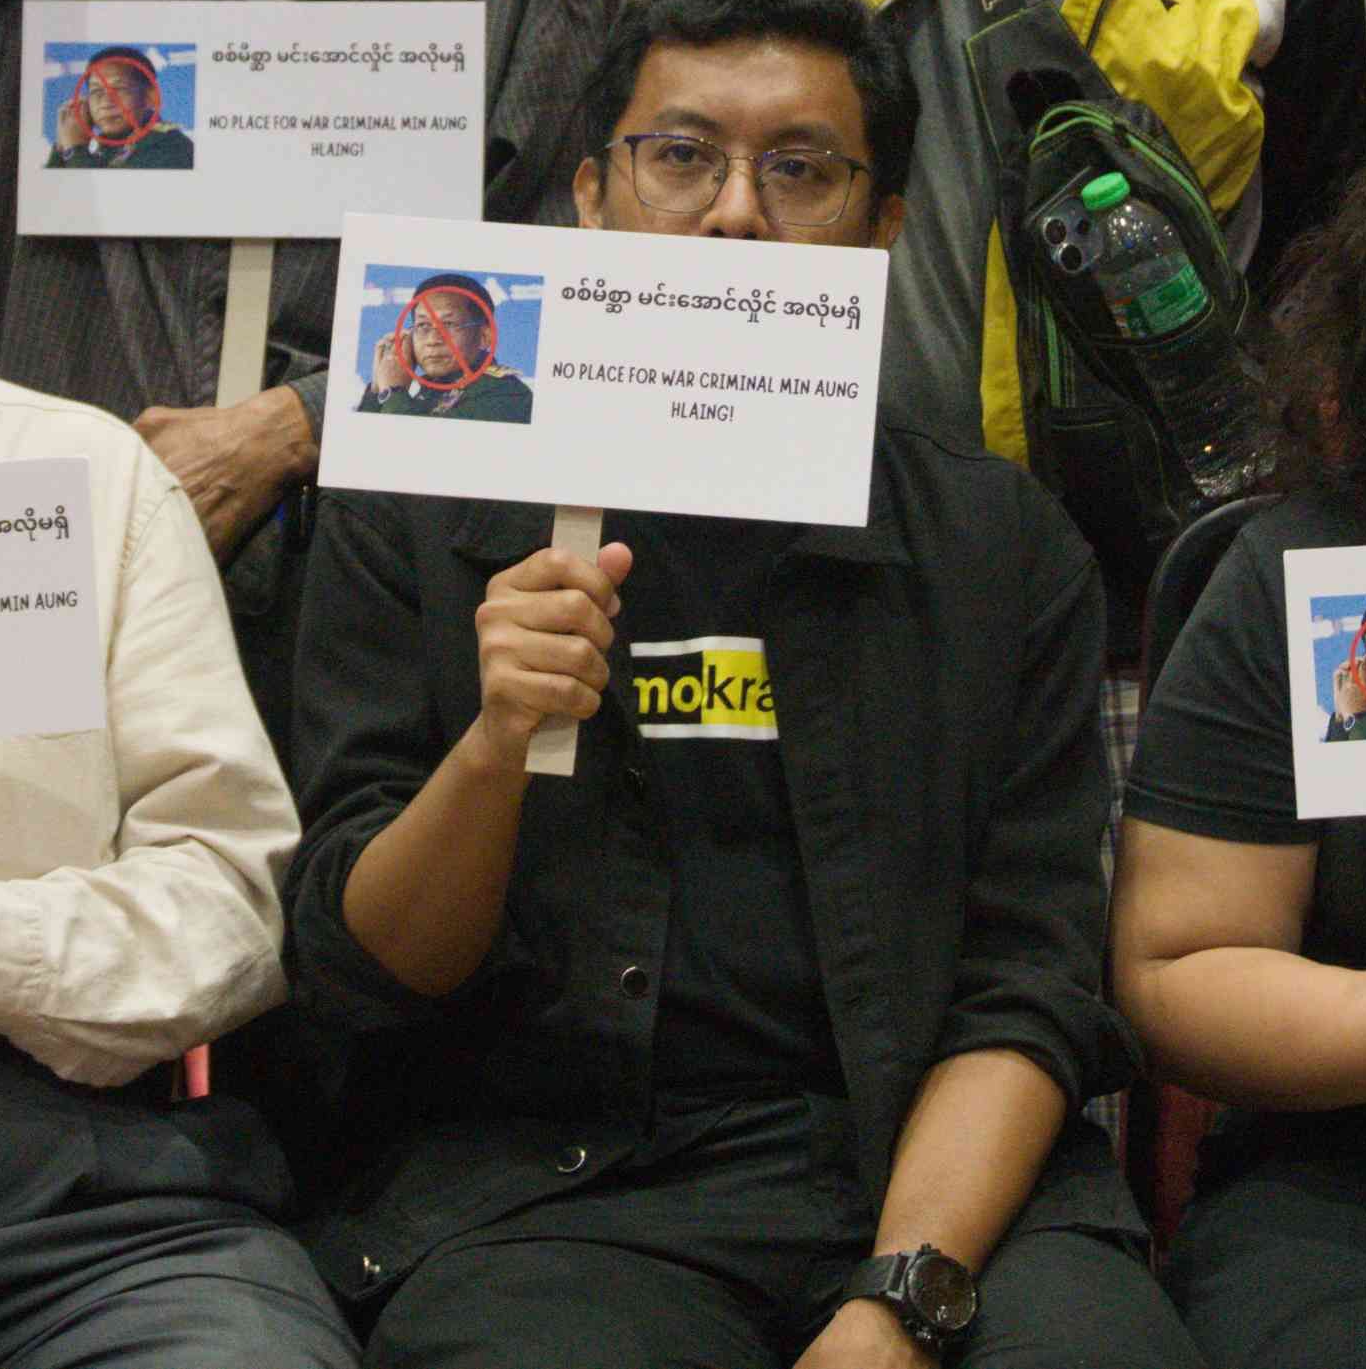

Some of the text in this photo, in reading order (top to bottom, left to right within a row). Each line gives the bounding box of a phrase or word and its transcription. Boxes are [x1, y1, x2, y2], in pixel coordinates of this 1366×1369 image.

[209, 115, 467, 131] NO PLACE FOR WAR CRIMINAL MIN AUNG
[311, 142, 364, 157] HLAING!
[638, 282, 776, 323] မင်းအောင်လှိုင်
[783, 293, 861, 330] အလိုမရှိ
[553, 362, 859, 399] NO PLACE FOR WAR CRIMINAL MIN AUNG
[671, 401, 734, 422] HLAING!
[0, 594, 30, 612] MIN
[34, 590, 78, 610] AUNG
